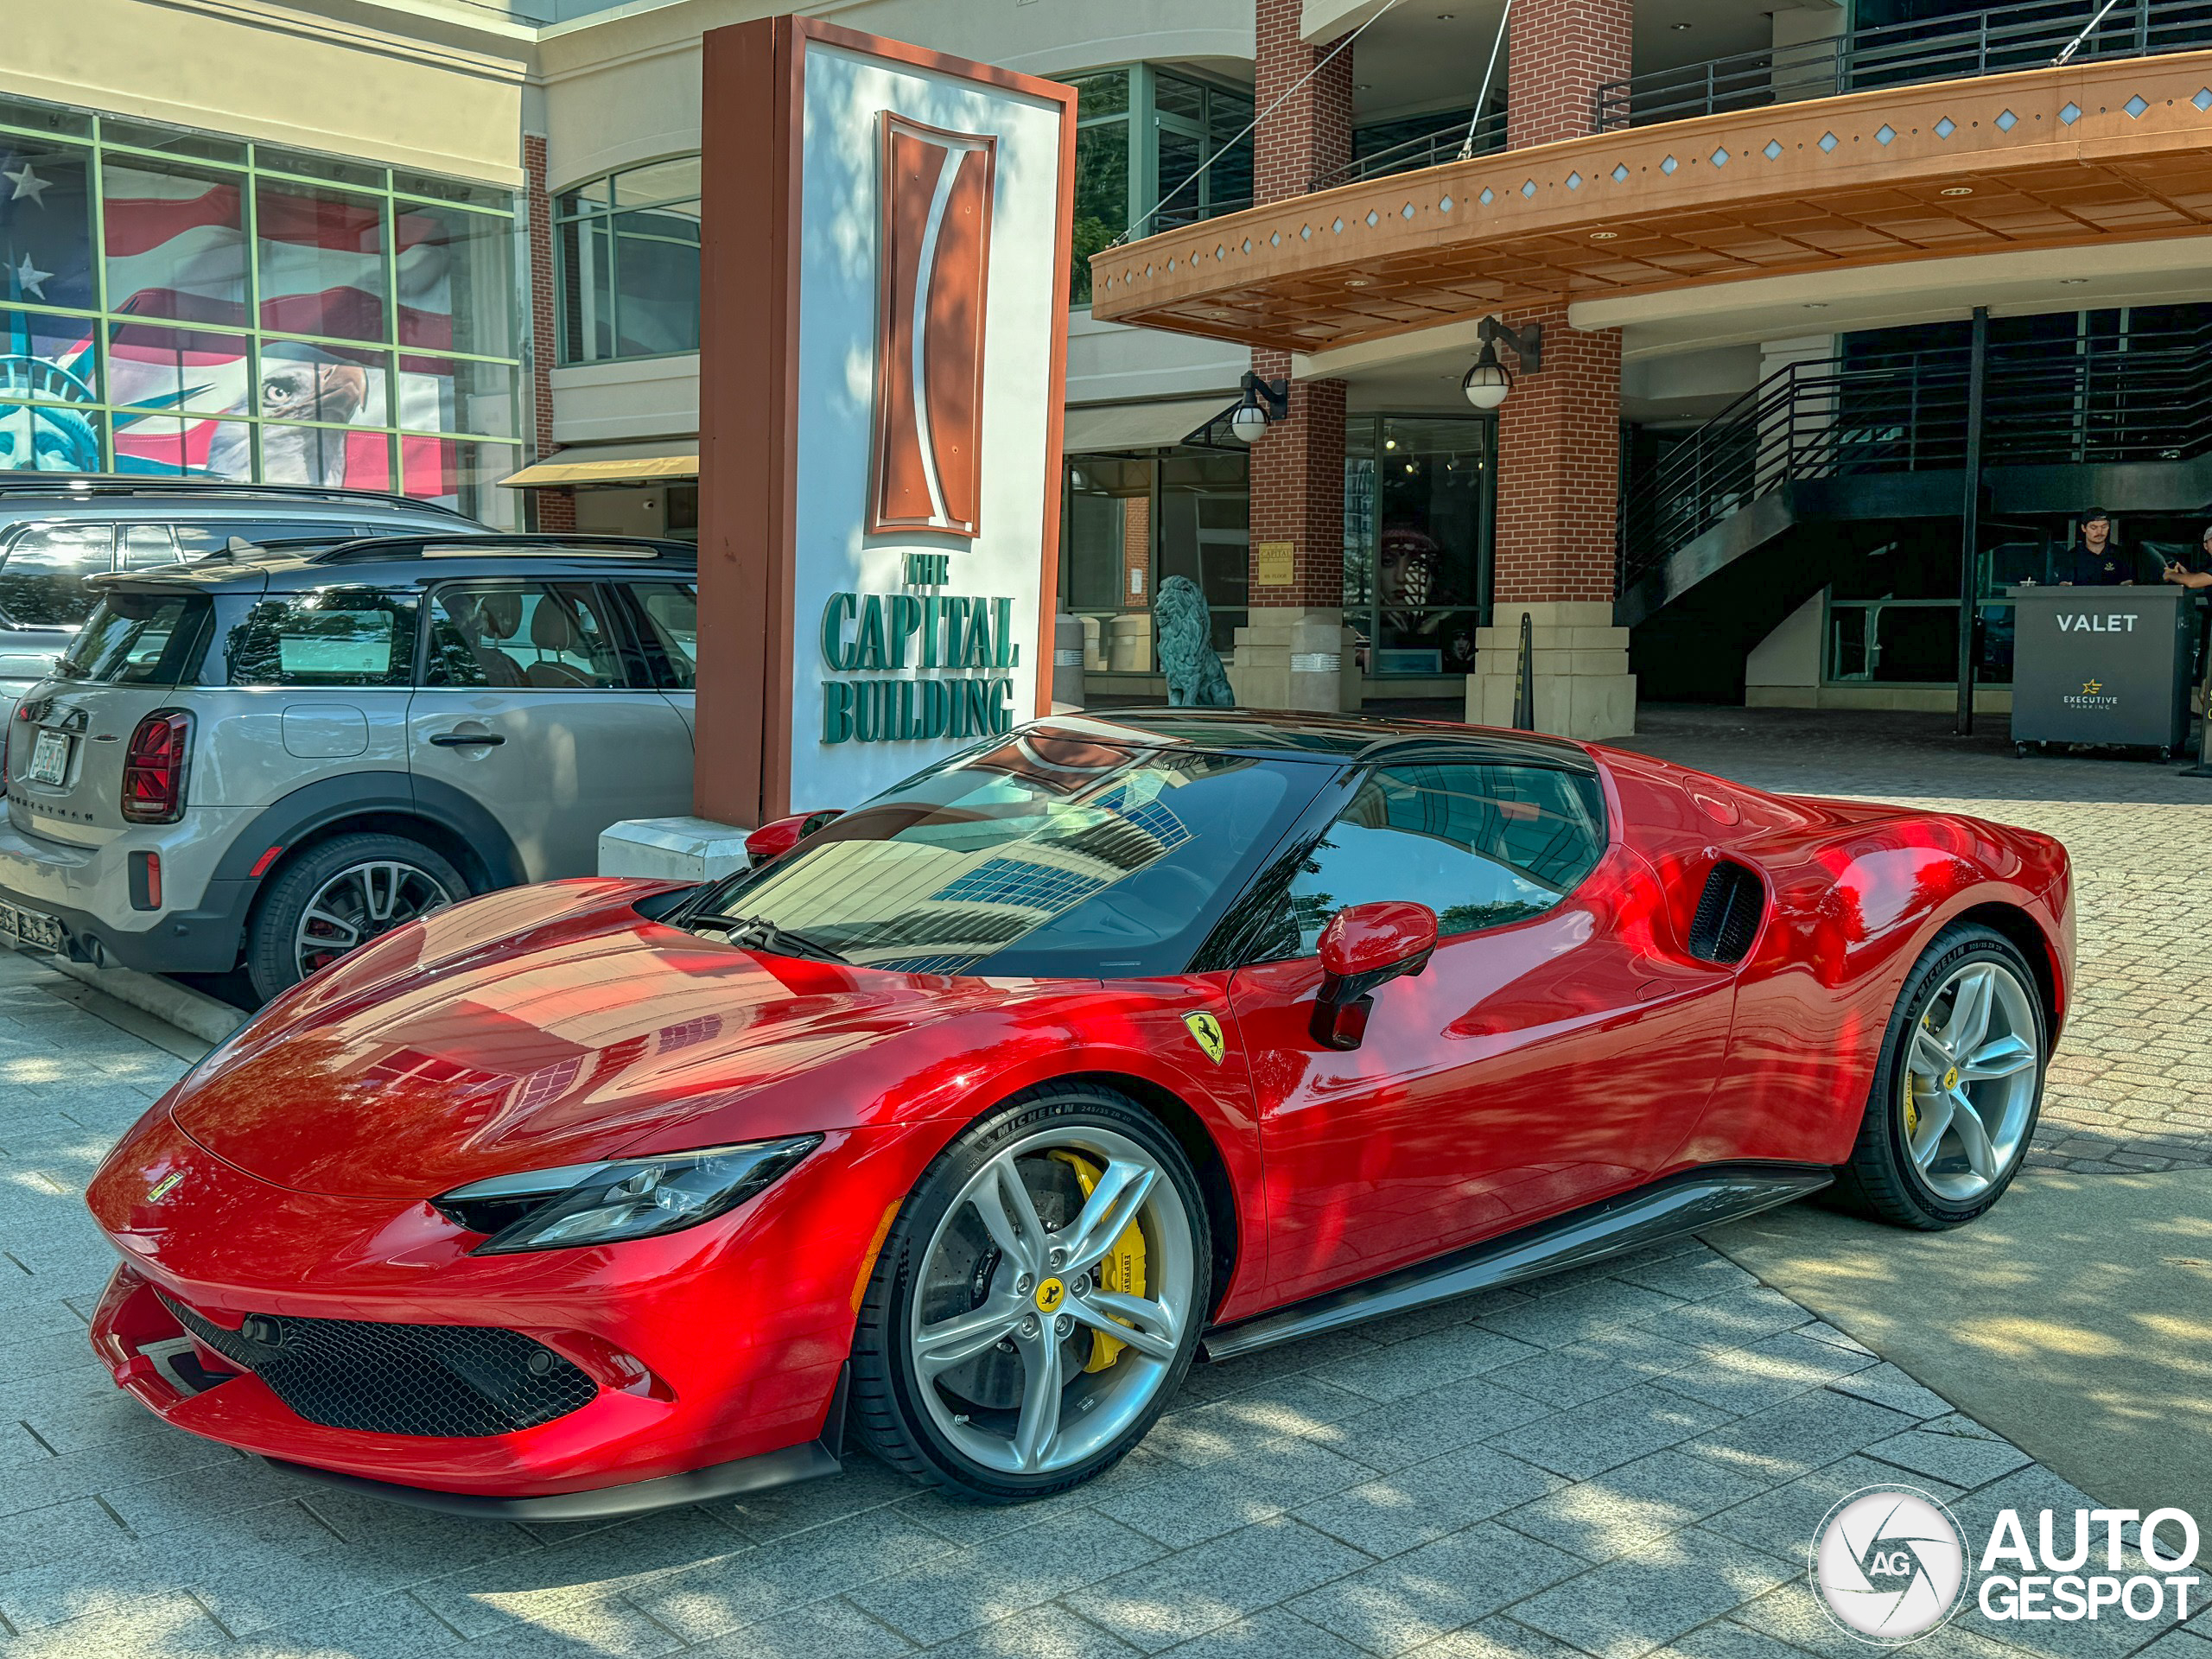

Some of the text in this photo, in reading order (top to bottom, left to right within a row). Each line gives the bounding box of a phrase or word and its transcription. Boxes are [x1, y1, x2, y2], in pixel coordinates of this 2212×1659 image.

[902, 552, 950, 585] THE
[821, 592, 1020, 671] CAPITAL
[2056, 614, 2139, 632] VALET
[820, 677, 1015, 744] BUILDING
[2063, 696, 2118, 704] EXECUTIVE
[1918, 944, 1965, 998] MICHELIN
[1081, 1105, 1109, 1115] 245/35
